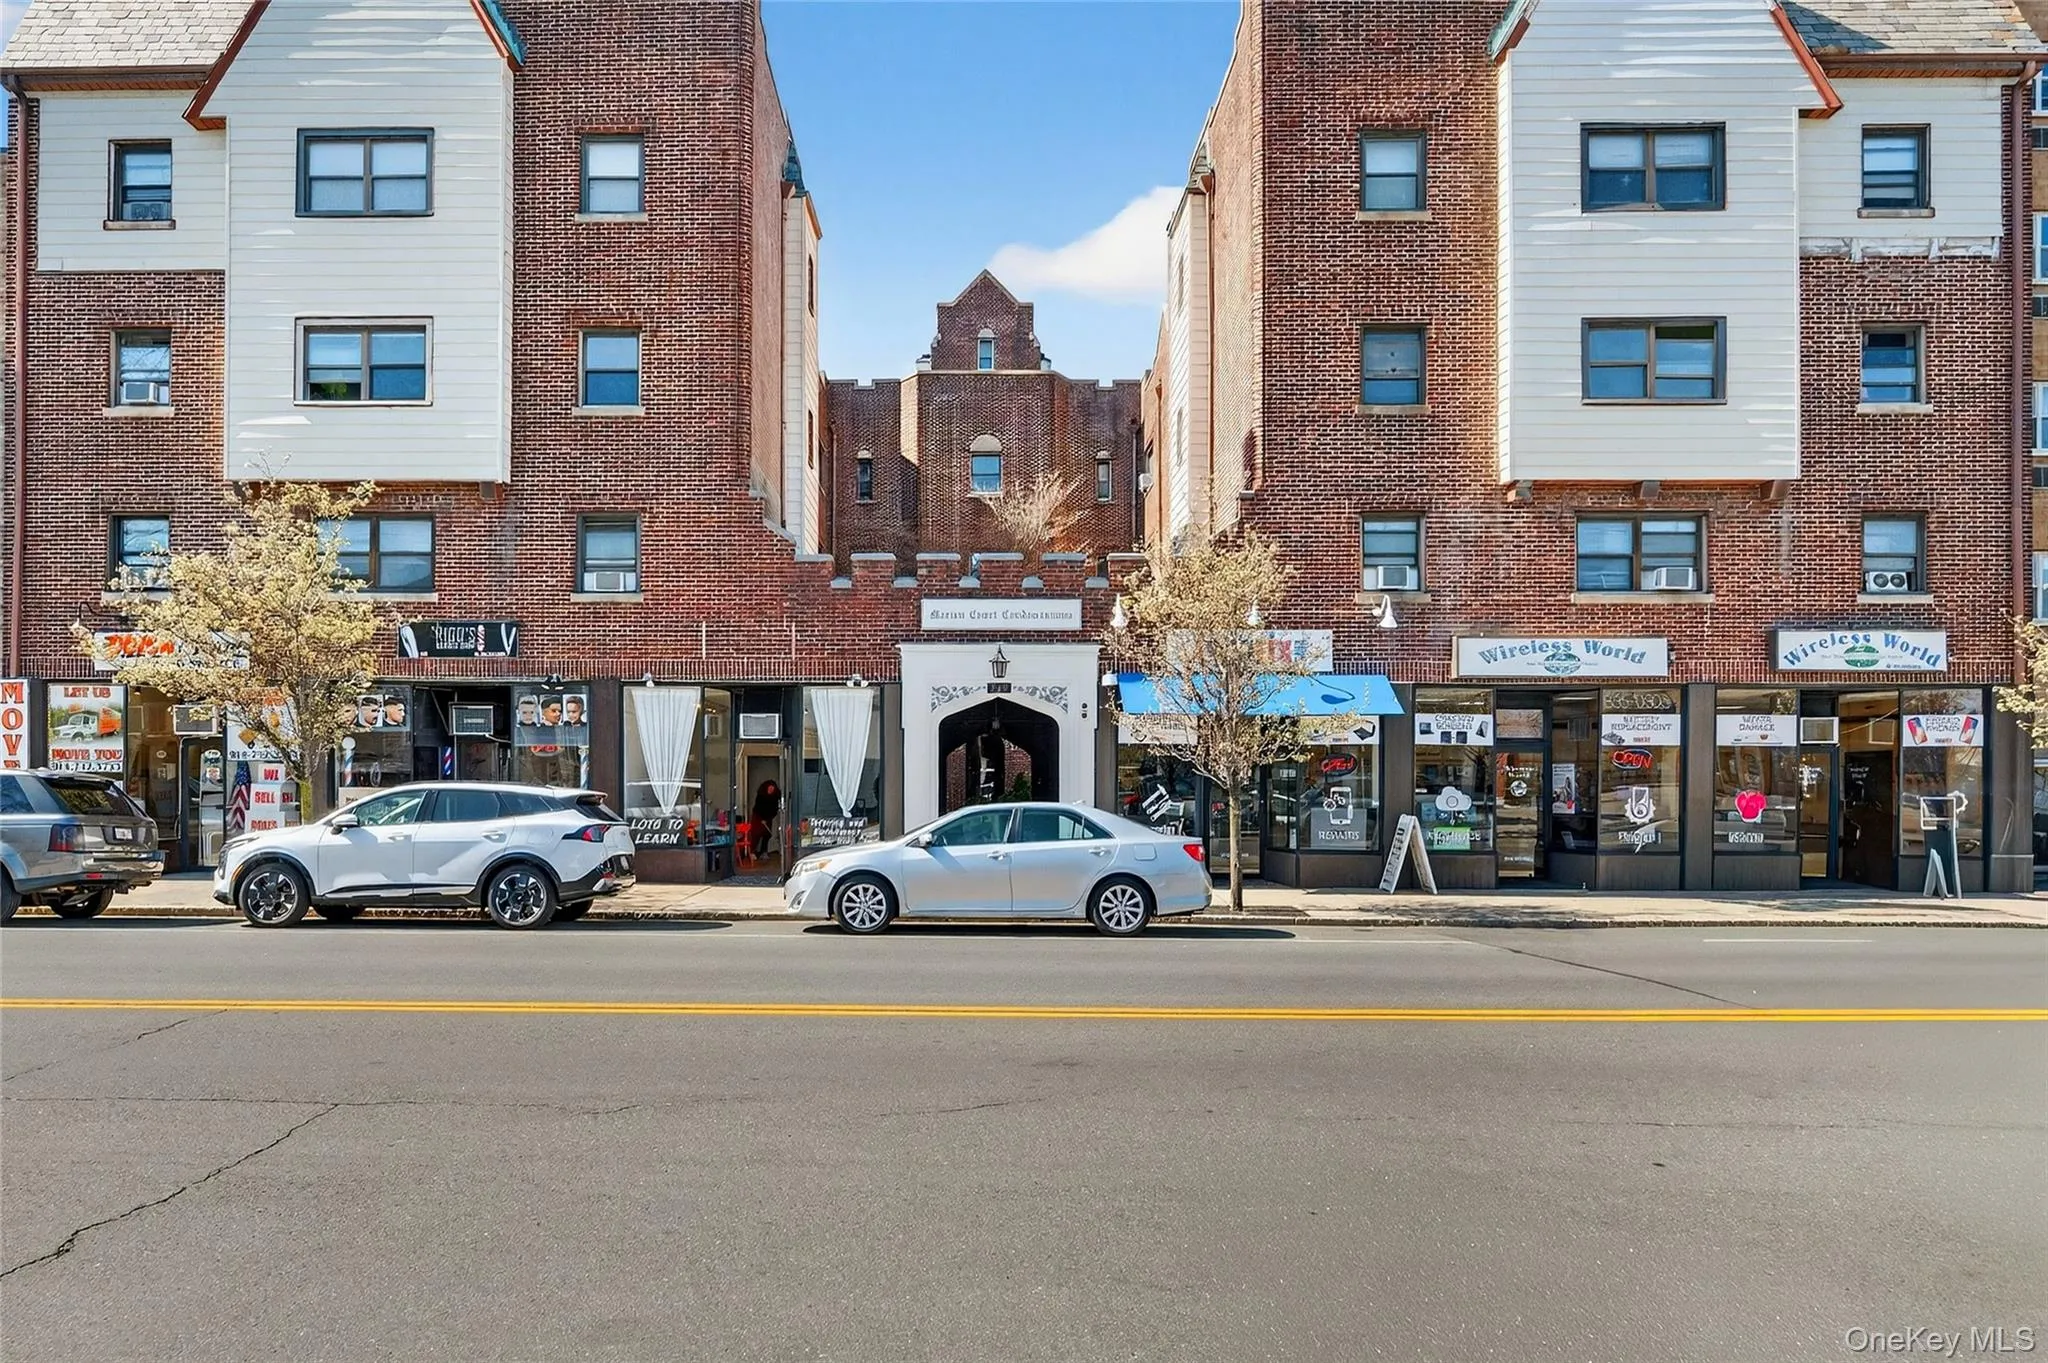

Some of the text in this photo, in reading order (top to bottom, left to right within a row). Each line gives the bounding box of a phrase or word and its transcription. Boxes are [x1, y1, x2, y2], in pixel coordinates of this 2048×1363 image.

[1479, 640, 1646, 664] Wireless World
[1783, 632, 1943, 668] Wireless World
[64, 687, 89, 698] LET
[94, 749, 122, 760] YOU
[1613, 751, 1652, 768] OPEN
[668, 818, 684, 830] TO
[635, 833, 680, 844] LEARN
